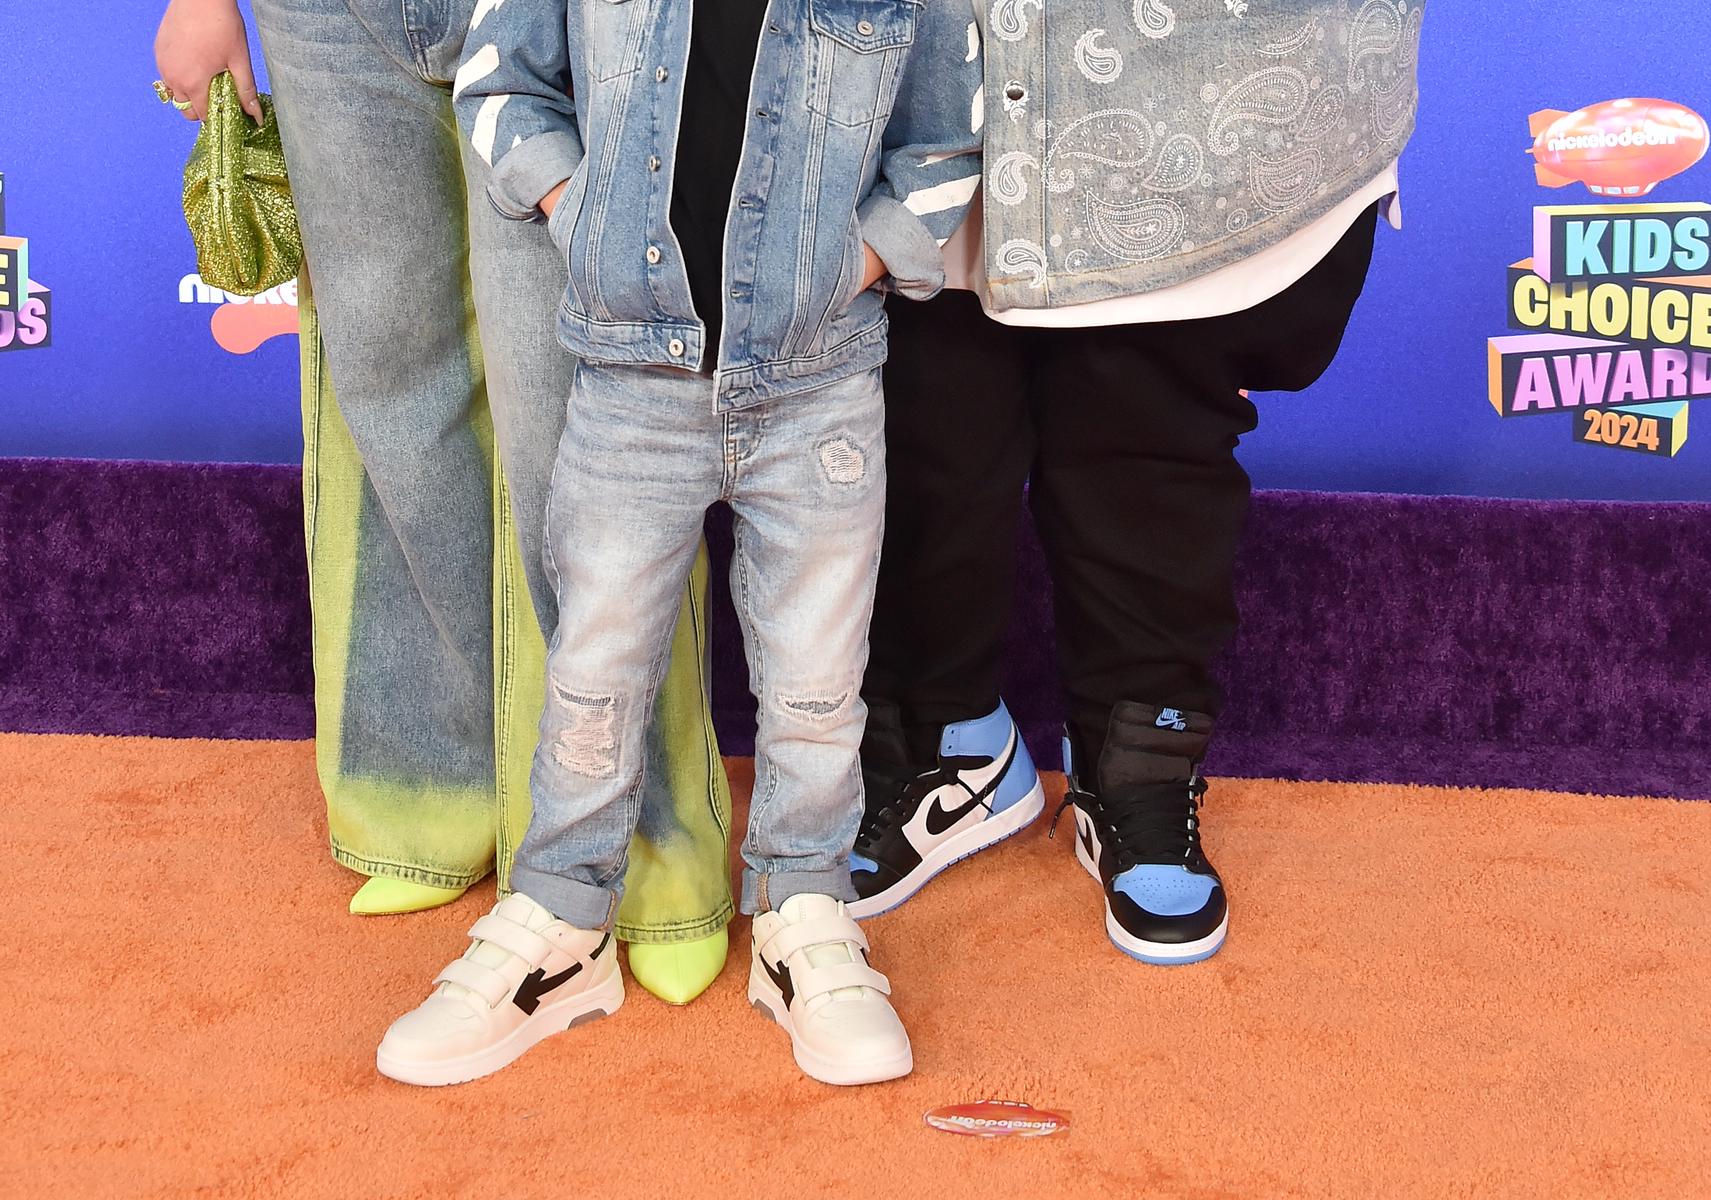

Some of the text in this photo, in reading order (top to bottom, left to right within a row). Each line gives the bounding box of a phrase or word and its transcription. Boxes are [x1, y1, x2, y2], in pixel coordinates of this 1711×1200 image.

[1548, 126, 1677, 151] nickelodeon
[1566, 217, 1709, 276] KIDS
[1513, 275, 1711, 349] CHOICE
[1584, 409, 1659, 451] 2024
[1162, 707, 1181, 720] NIKE
